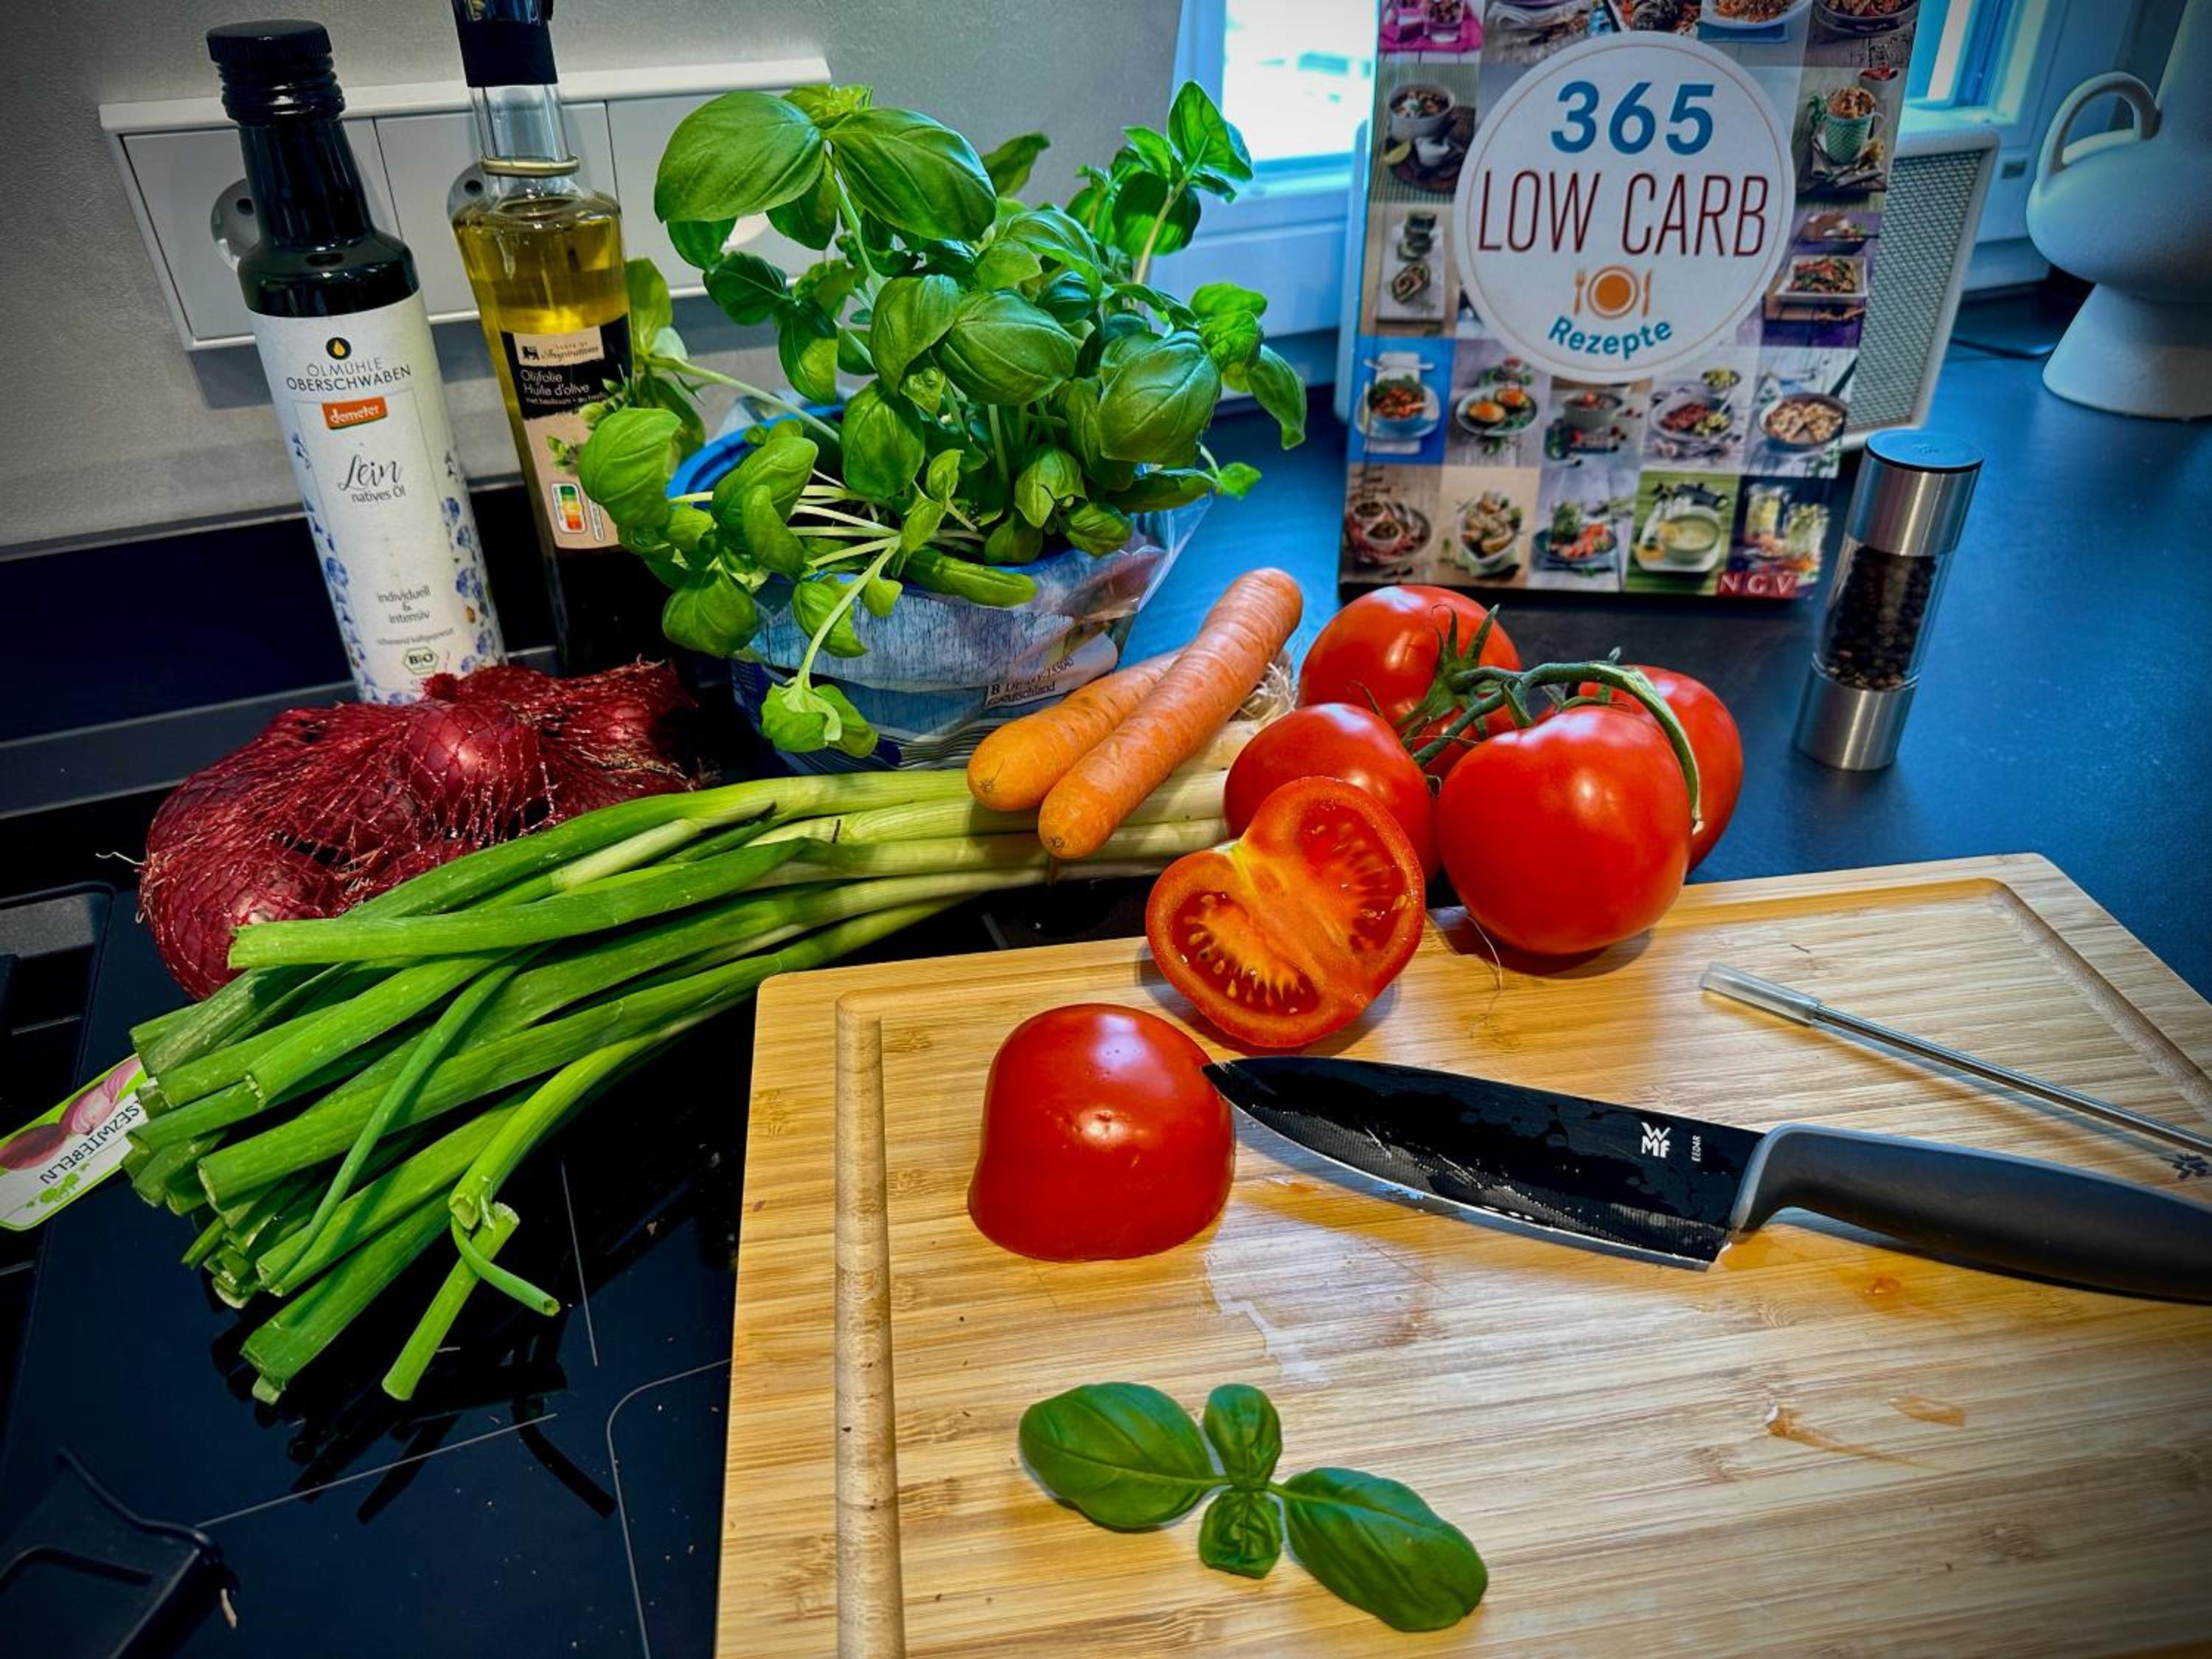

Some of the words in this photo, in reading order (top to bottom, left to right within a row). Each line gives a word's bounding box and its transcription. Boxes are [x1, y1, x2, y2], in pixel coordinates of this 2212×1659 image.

[1549, 80, 1714, 156] 365
[1478, 170, 1601, 254] LOW
[1621, 172, 1770, 258] CARB
[1547, 316, 1673, 361] Rezepte
[285, 364, 413, 392] OBERSCHWABEN
[523, 382, 552, 396] Huile
[554, 383, 590, 396] d'olive
[330, 404, 380, 425] demeter
[337, 453, 403, 492] Lein
[352, 491, 392, 503] natives
[377, 585, 431, 602] individuell
[389, 611, 430, 625] intensiv
[40, 1099, 142, 1184] SEZWIEBELN
[1641, 1121, 1672, 1158] WMF
